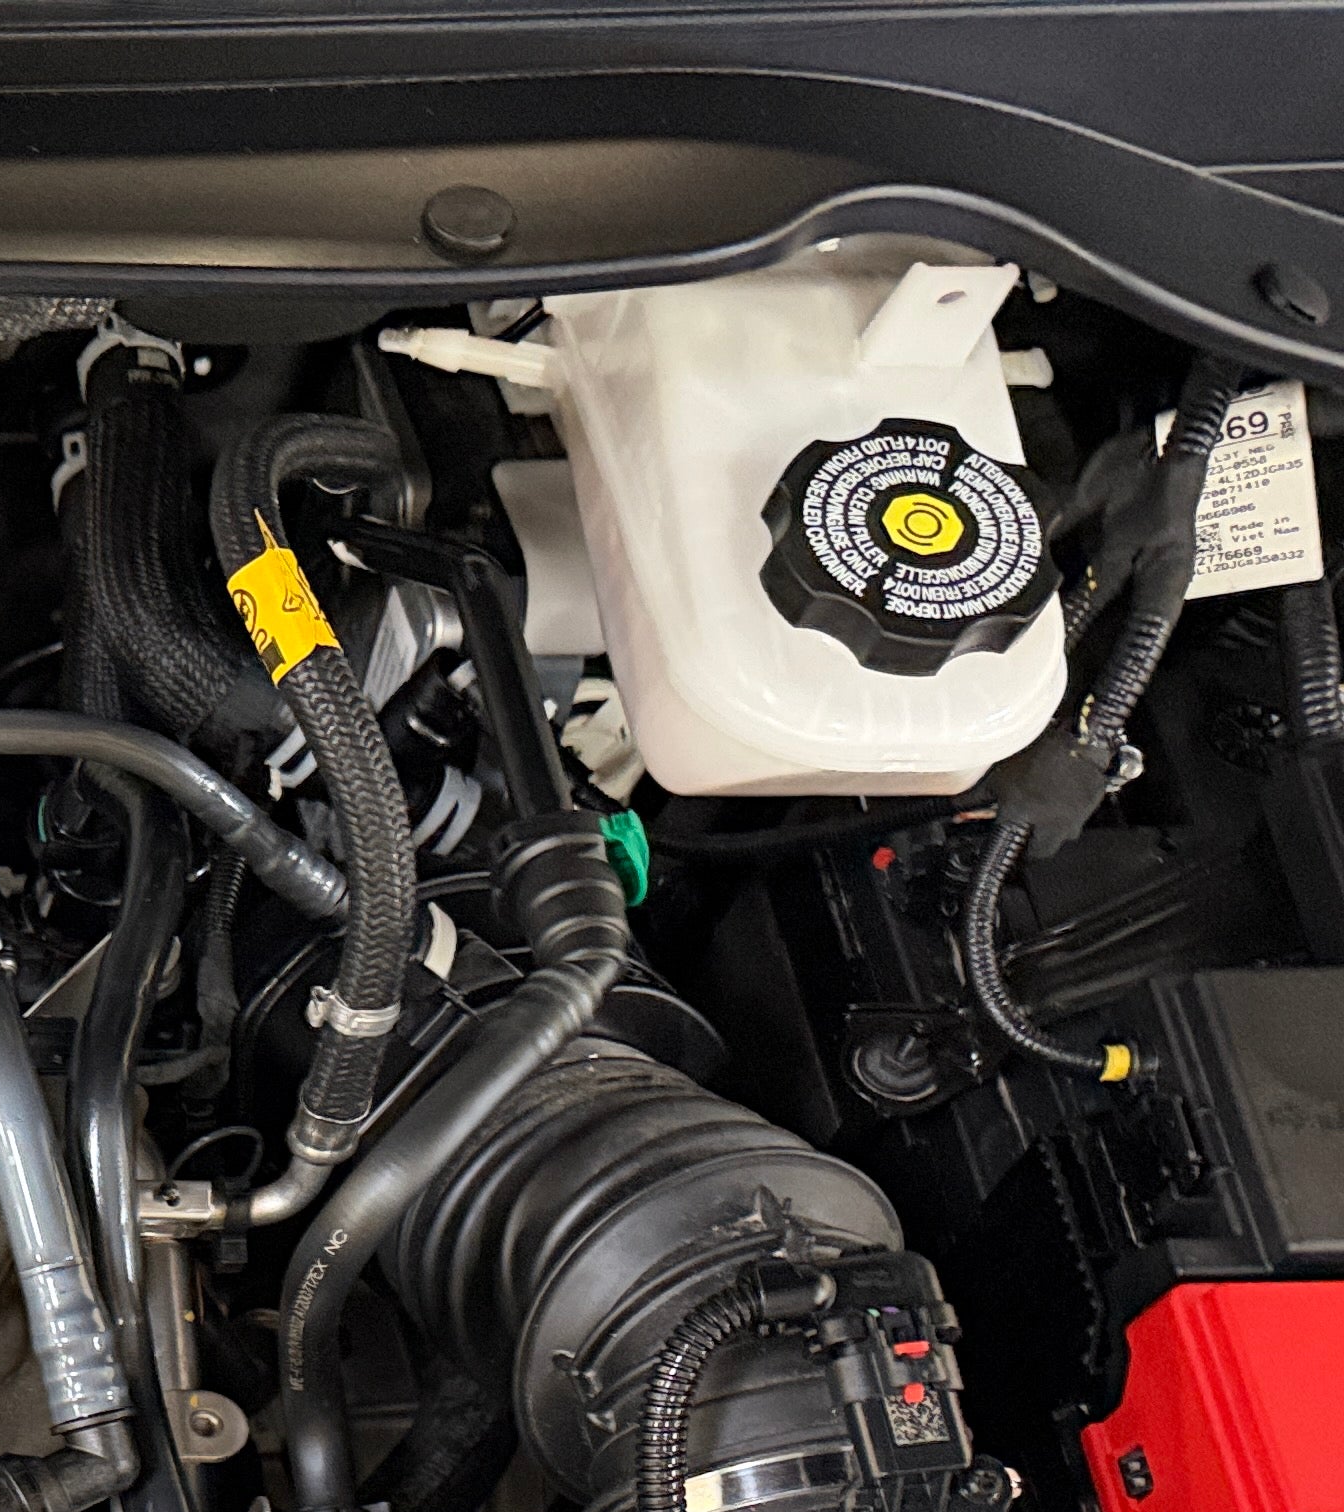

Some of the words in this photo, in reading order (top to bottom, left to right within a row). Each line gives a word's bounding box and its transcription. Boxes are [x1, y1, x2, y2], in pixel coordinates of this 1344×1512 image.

[857, 435, 905, 456] FLUID
[915, 436, 951, 455] DOT
[819, 445, 864, 476] FROM
[851, 451, 911, 477] BEFORE
[911, 453, 947, 470] CAP
[864, 469, 943, 493] WARNING:
[802, 477, 829, 525] SEALED
[847, 485, 876, 525] CLEAN
[946, 479, 997, 539] PROVENANT
[1212, 496, 1236, 508] BAT
[1000, 521, 1018, 543] QUE
[1014, 501, 1041, 557] NETTOYER
[1230, 521, 1264, 532] Made
[1232, 531, 1264, 542] Viet
[1274, 526, 1299, 535] Nam
[827, 527, 853, 551] USE
[849, 527, 891, 567] FILLER
[839, 548, 881, 582] ONLY
[945, 555, 984, 581] BIDON
[972, 555, 1013, 591] LIQUIDE
[1016, 554, 1039, 573] LE
[891, 579, 920, 599] DOT
[923, 585, 963, 600] FREIN
[979, 567, 1032, 610] BOUCHON
[940, 597, 987, 619] AVANT
